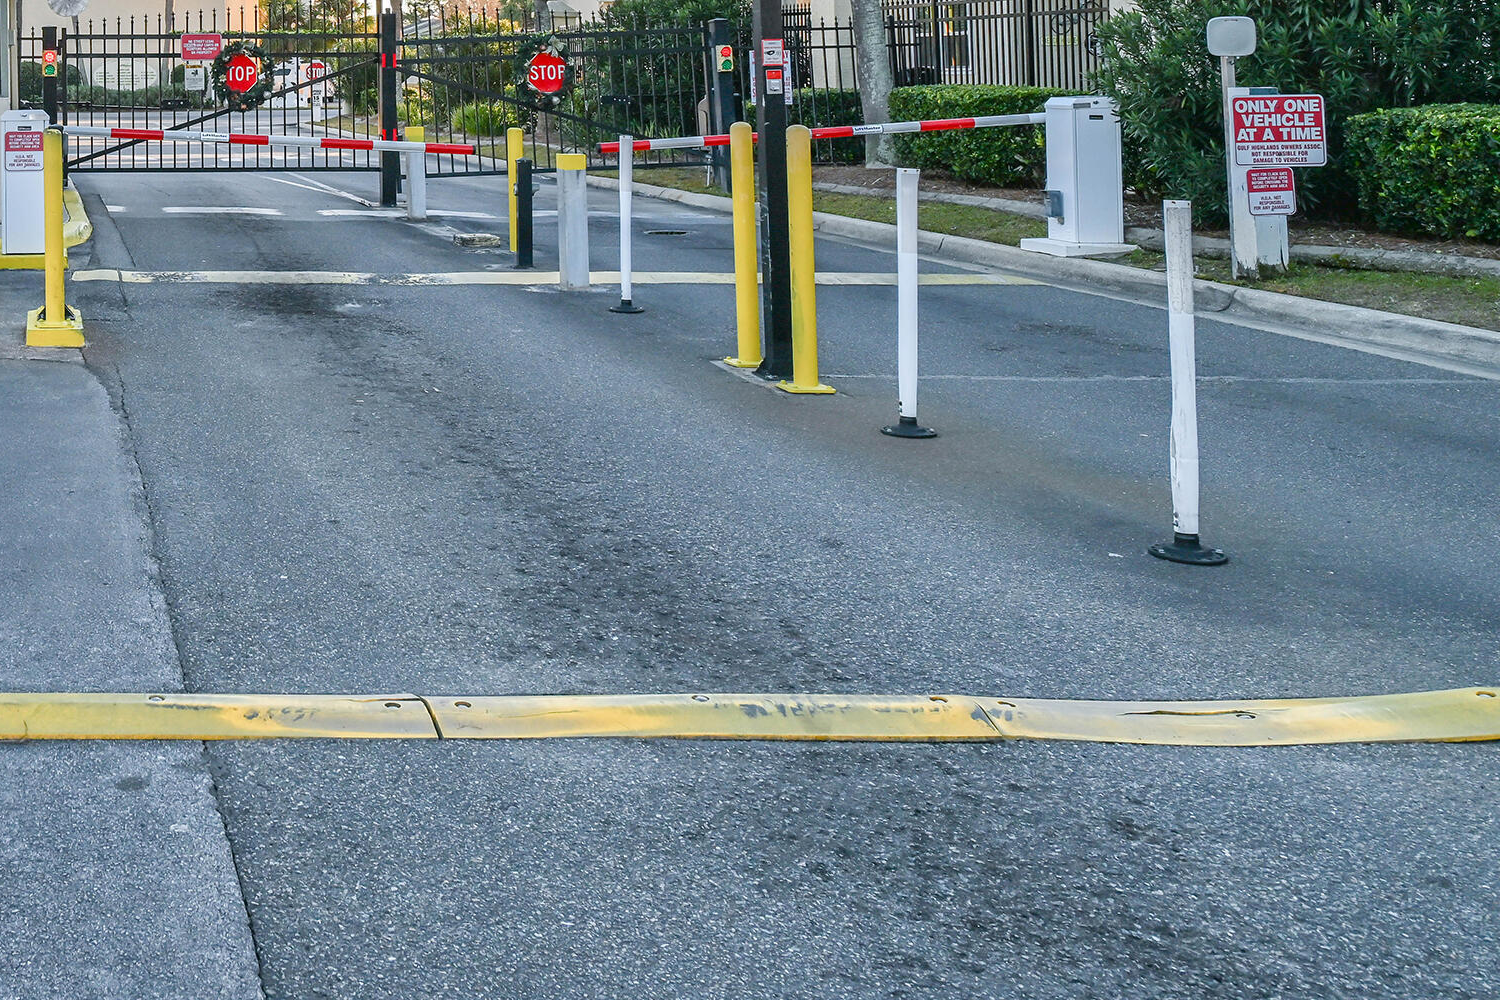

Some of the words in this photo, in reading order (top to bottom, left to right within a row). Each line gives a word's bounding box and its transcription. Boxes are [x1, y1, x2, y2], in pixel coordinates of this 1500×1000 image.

[229, 66, 255, 81] TOP
[530, 65, 565, 80] STOP
[1234, 100, 1278, 113] ONLY
[1283, 99, 1320, 112] ONE
[1241, 113, 1315, 126] VEHICLE
[1237, 128, 1257, 141] AT
[1262, 128, 1275, 141] A
[1279, 127, 1322, 140] TIME
